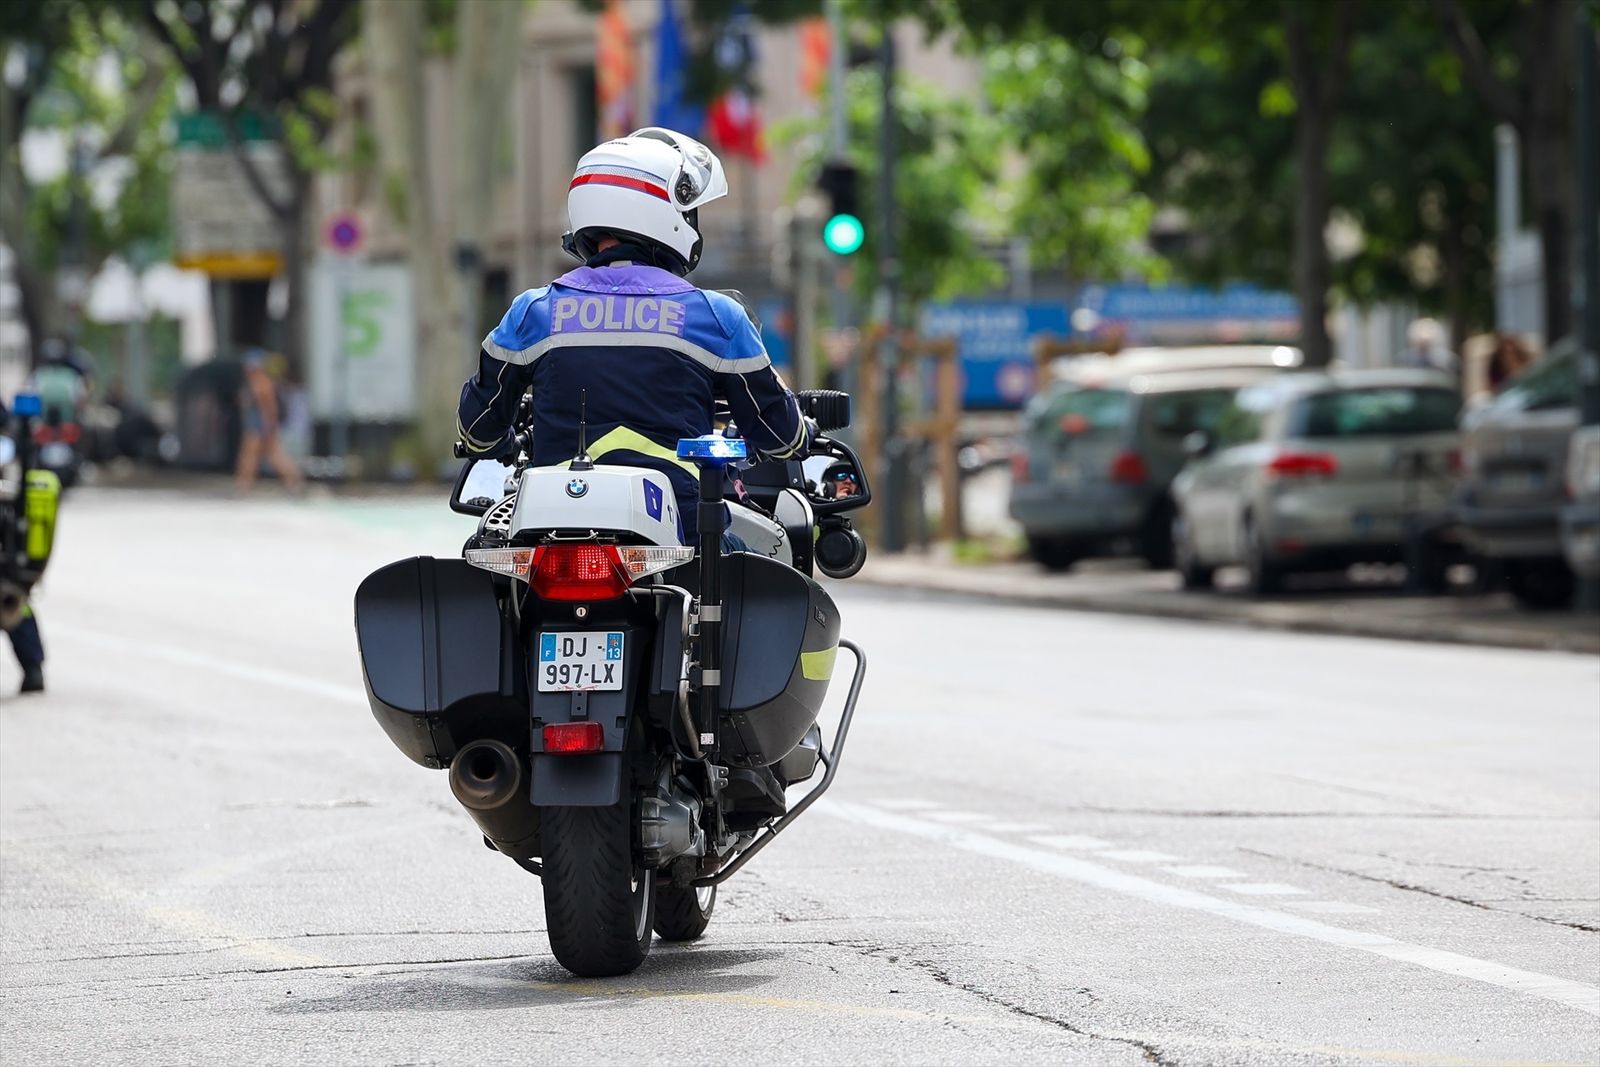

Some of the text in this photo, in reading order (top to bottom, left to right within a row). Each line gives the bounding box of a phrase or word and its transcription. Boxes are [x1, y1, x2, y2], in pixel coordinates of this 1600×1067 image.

[553, 296, 681, 334] POLICE
[562, 637, 587, 657] DJ
[607, 648, 621, 658] 13
[546, 663, 615, 685] 997-LX
